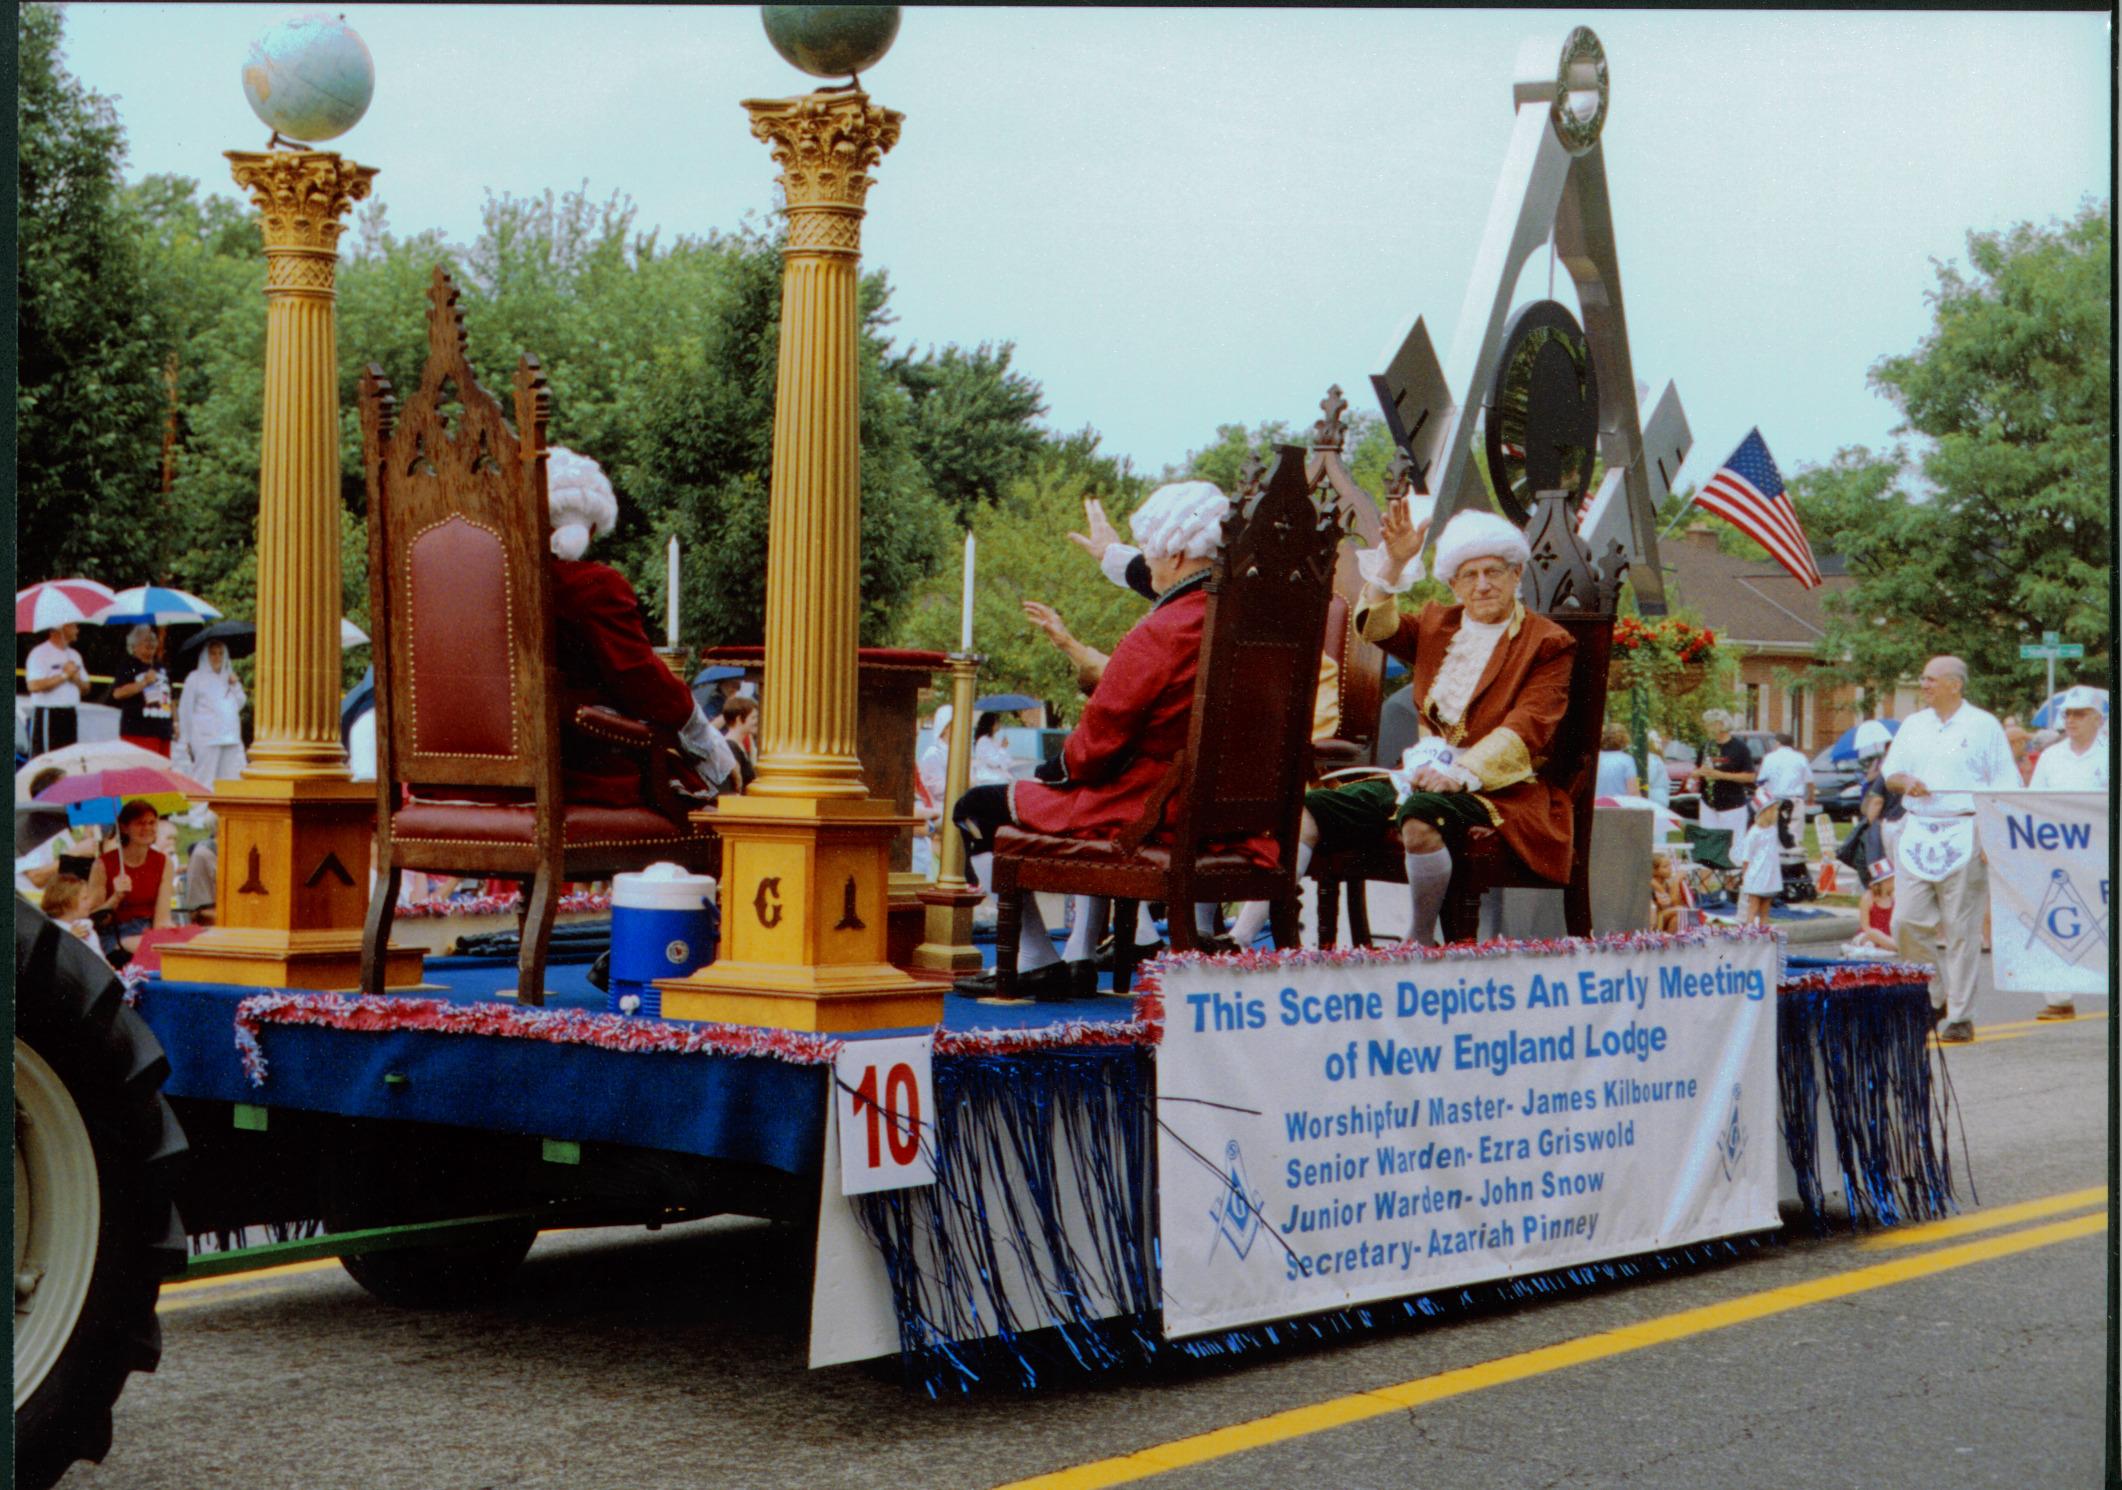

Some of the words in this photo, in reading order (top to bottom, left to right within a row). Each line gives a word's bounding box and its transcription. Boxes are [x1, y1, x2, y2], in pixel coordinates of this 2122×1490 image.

[2006, 813, 2091, 851] New
[2047, 906, 2081, 940] G
[1186, 991, 1267, 1032] This
[1280, 987, 1383, 1026] Scene
[1396, 976, 1516, 1025] Depicts
[1527, 974, 1570, 1009] An
[1578, 968, 1649, 1010] Early
[1659, 963, 1766, 1001] Meeting
[1324, 1041, 1358, 1082] of
[1368, 1039, 1442, 1077] New
[1454, 1025, 1575, 1077] England
[1585, 1020, 1667, 1062] Lodge
[852, 1062, 921, 1169] 10
[1285, 1100, 1420, 1143] Worshipful
[1428, 1096, 1513, 1127] Master-
[1521, 1088, 1597, 1117] James
[1604, 1078, 1697, 1108] Kilbourne
[1286, 1153, 1370, 1190] Senior
[1479, 1135, 1531, 1164] Ezra
[1538, 1119, 1636, 1158] Griswold
[1281, 1198, 1367, 1234] Junior
[1374, 1185, 1473, 1221] Warden-
[1479, 1175, 1533, 1208] John
[1541, 1170, 1605, 1199] Snow
[1285, 1240, 1422, 1282] Secretary-
[1427, 1219, 1514, 1259] Azariah
[1522, 1212, 1600, 1245] Pinney
